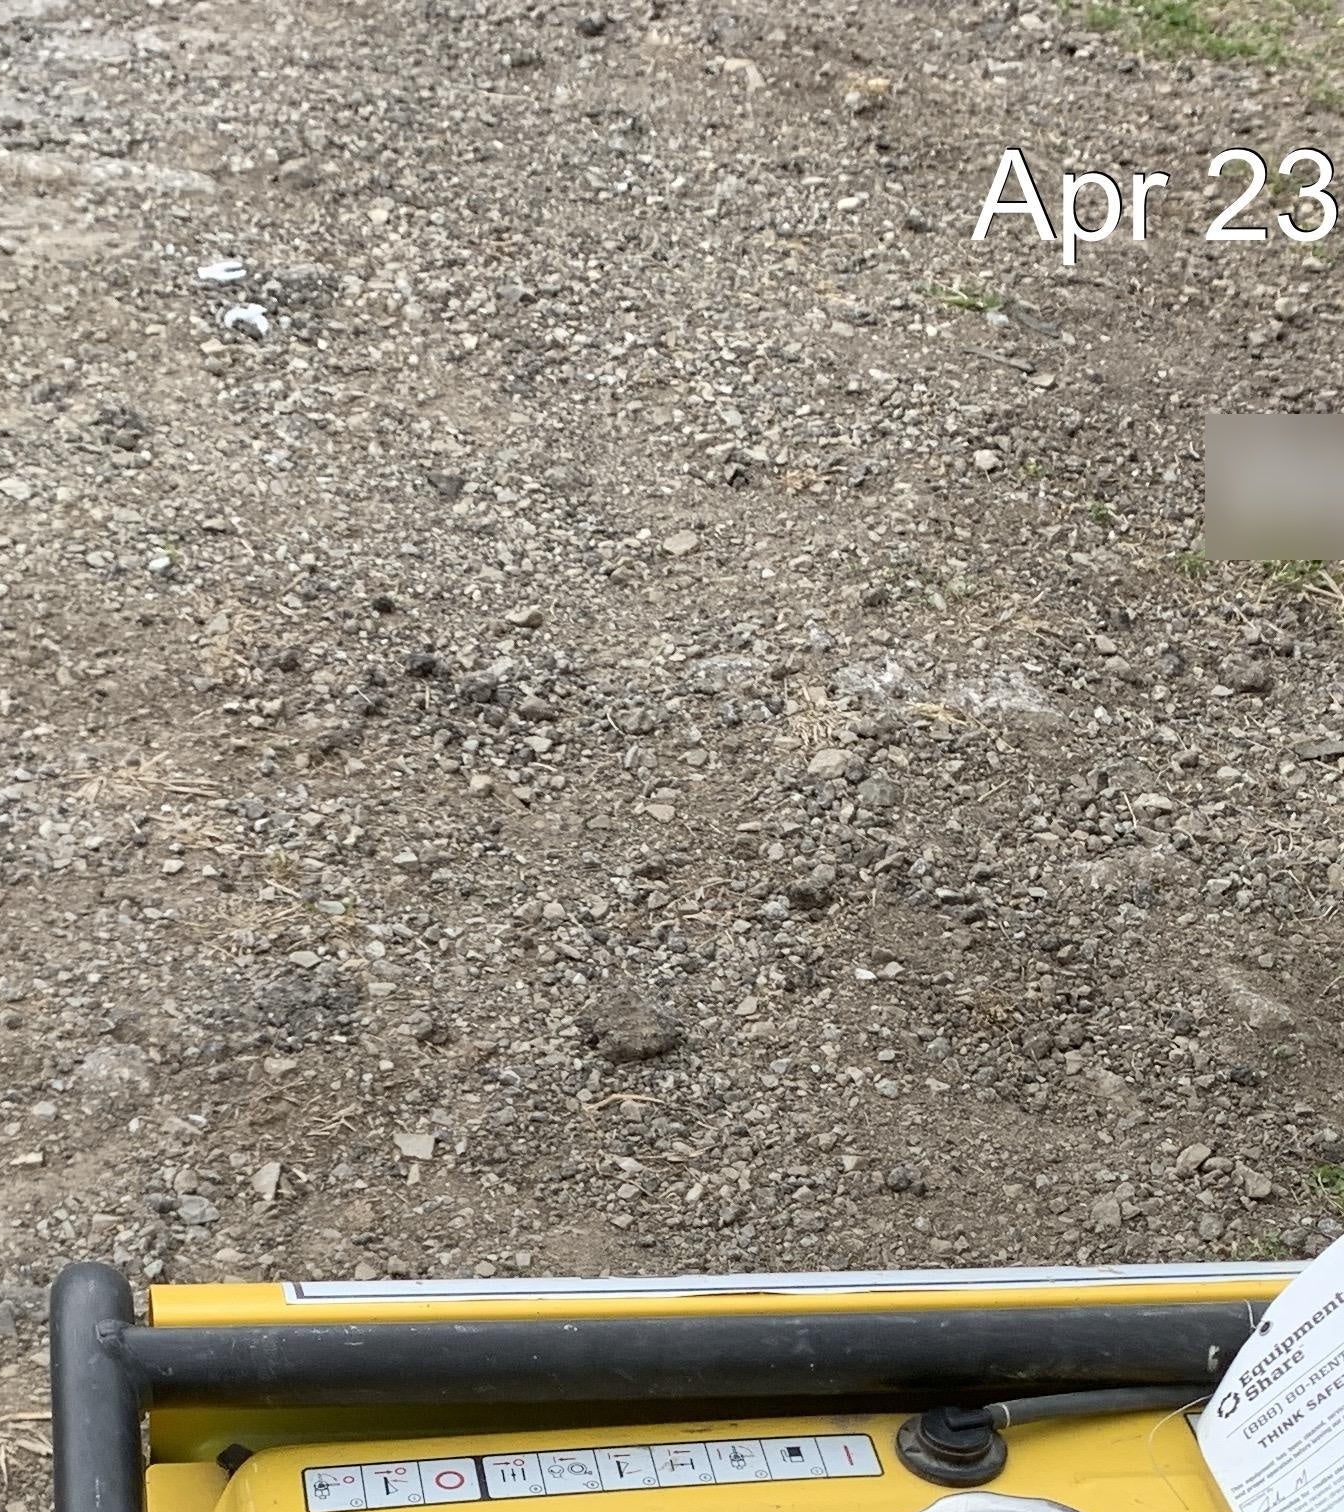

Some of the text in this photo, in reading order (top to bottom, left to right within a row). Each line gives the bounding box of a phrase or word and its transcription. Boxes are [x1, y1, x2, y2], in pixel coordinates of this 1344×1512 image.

[1245, 1350, 1305, 1401] Share
[1243, 1402, 1284, 1440] (888)
[1258, 1409, 1305, 1448] THINK
